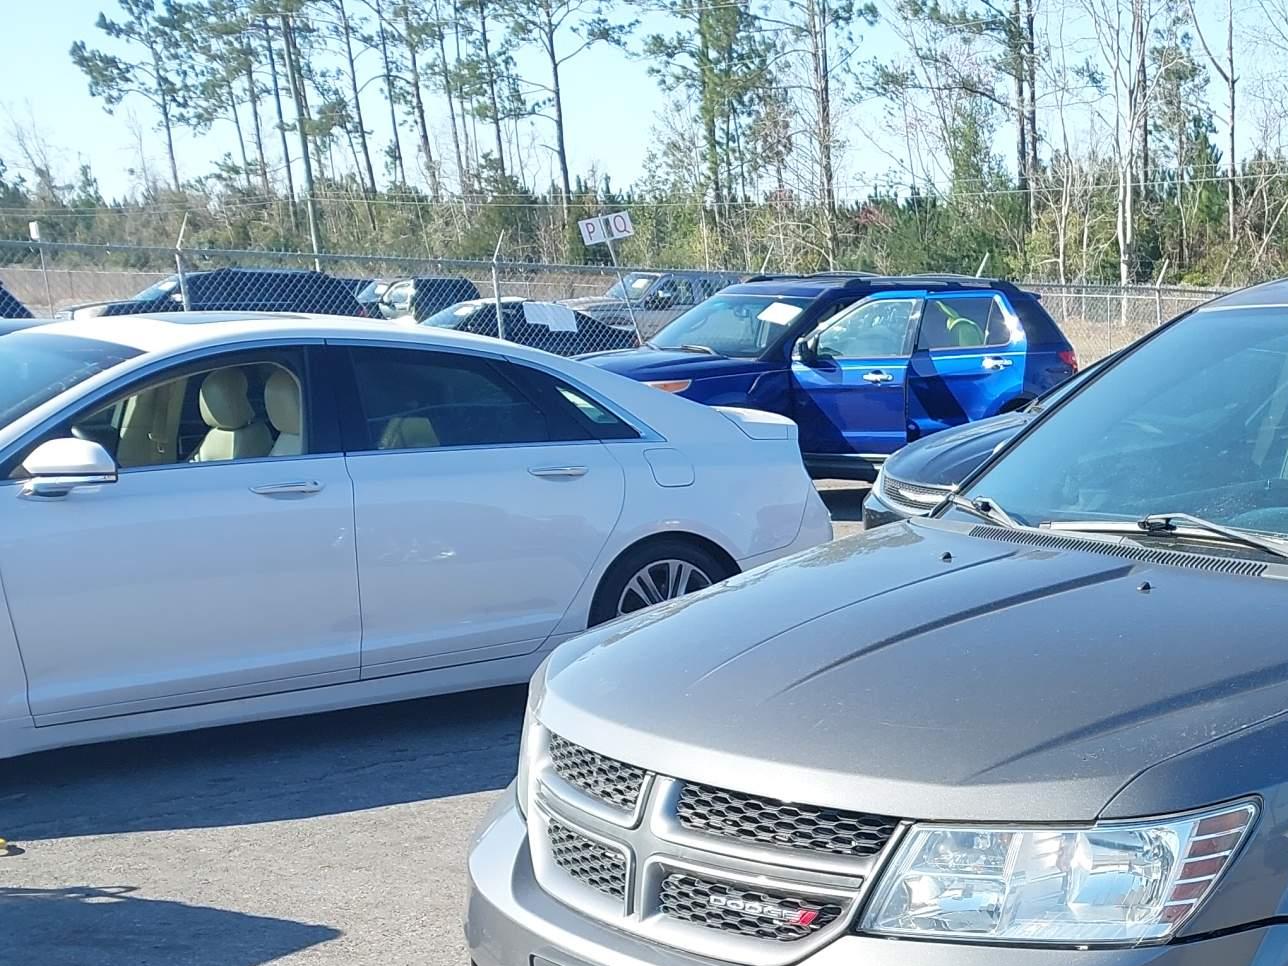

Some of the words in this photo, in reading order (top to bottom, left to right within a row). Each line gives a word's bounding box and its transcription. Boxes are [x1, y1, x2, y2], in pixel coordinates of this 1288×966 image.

[585, 222, 596, 241] P
[613, 214, 631, 234] Q
[708, 894, 802, 923] DODGE
